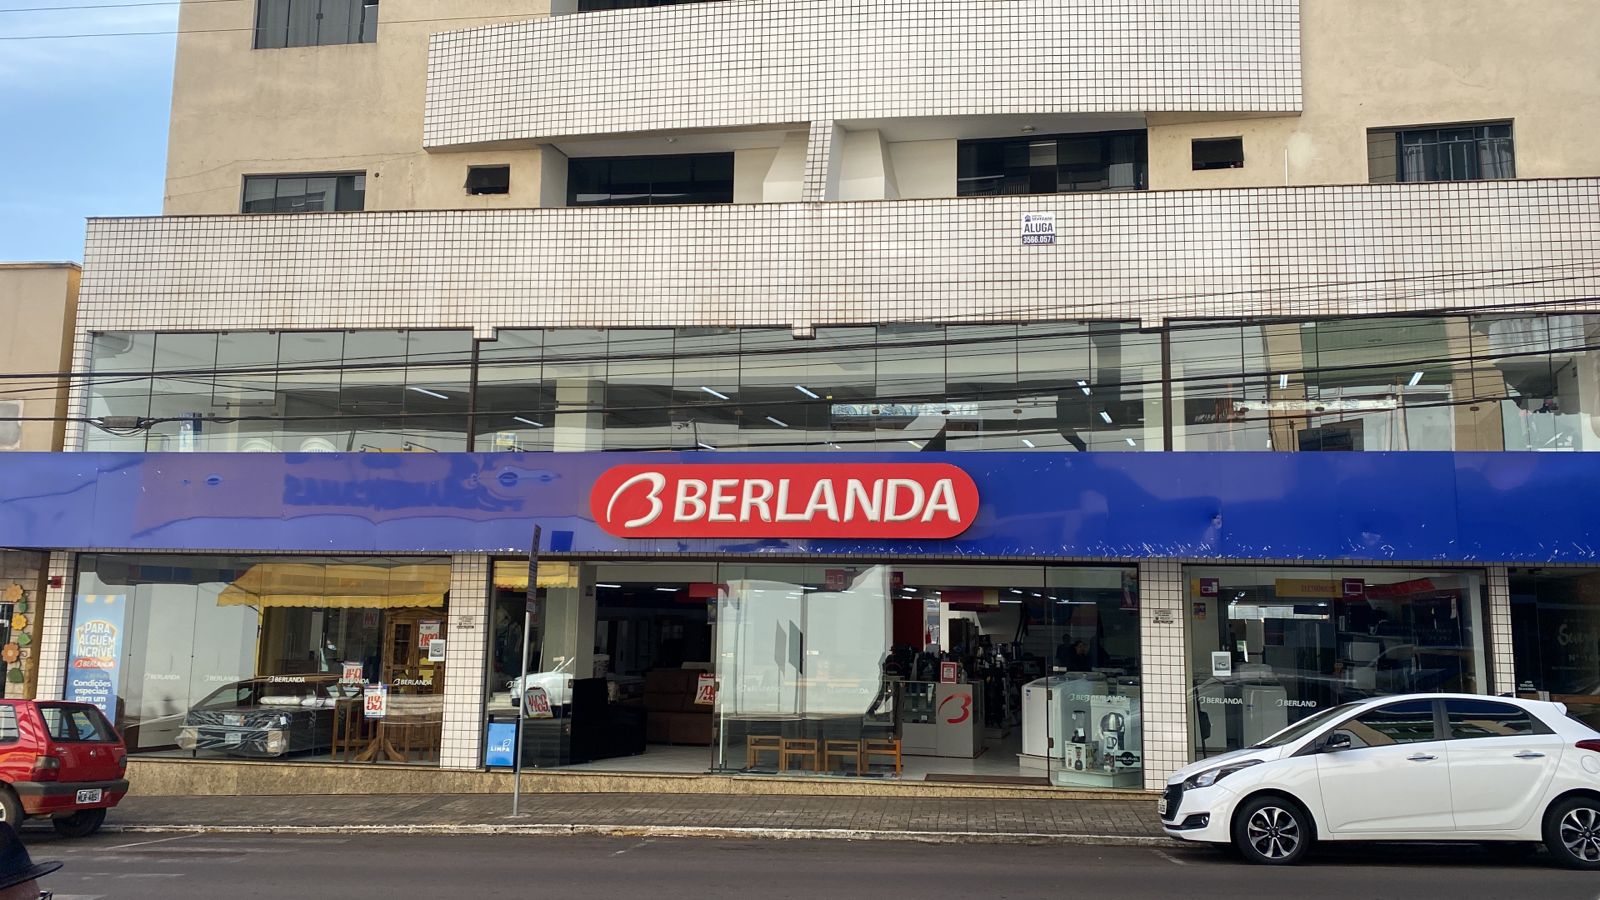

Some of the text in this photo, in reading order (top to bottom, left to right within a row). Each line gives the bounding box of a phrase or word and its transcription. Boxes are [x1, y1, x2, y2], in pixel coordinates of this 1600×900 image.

[1024, 222, 1053, 233] ALUGA
[673, 478, 961, 523] BERLANDA
[84, 622, 110, 634] PARA
[79, 632, 116, 646] ALGUÉM
[73, 679, 112, 687] Condições
[400, 678, 432, 686] BERLANDA
[74, 687, 109, 696] especiais
[1206, 697, 1243, 705] BERLANDA
